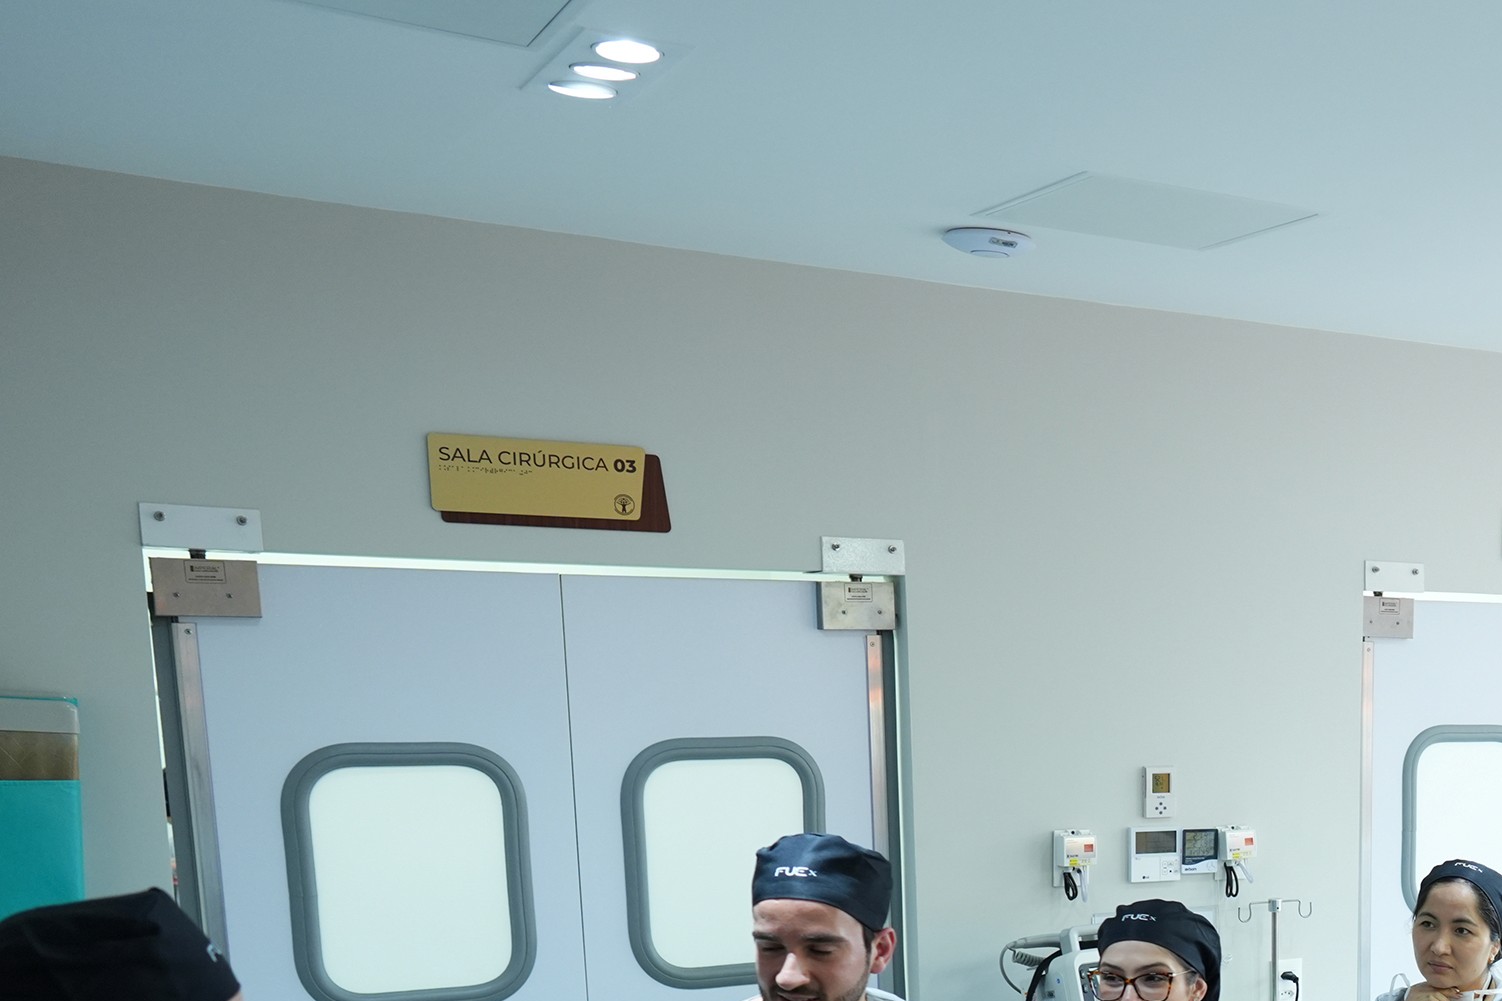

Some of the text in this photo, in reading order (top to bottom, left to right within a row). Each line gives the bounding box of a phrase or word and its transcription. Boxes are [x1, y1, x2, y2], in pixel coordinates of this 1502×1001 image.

[438, 446, 637, 473] SALA CIRÚRGICA 03
